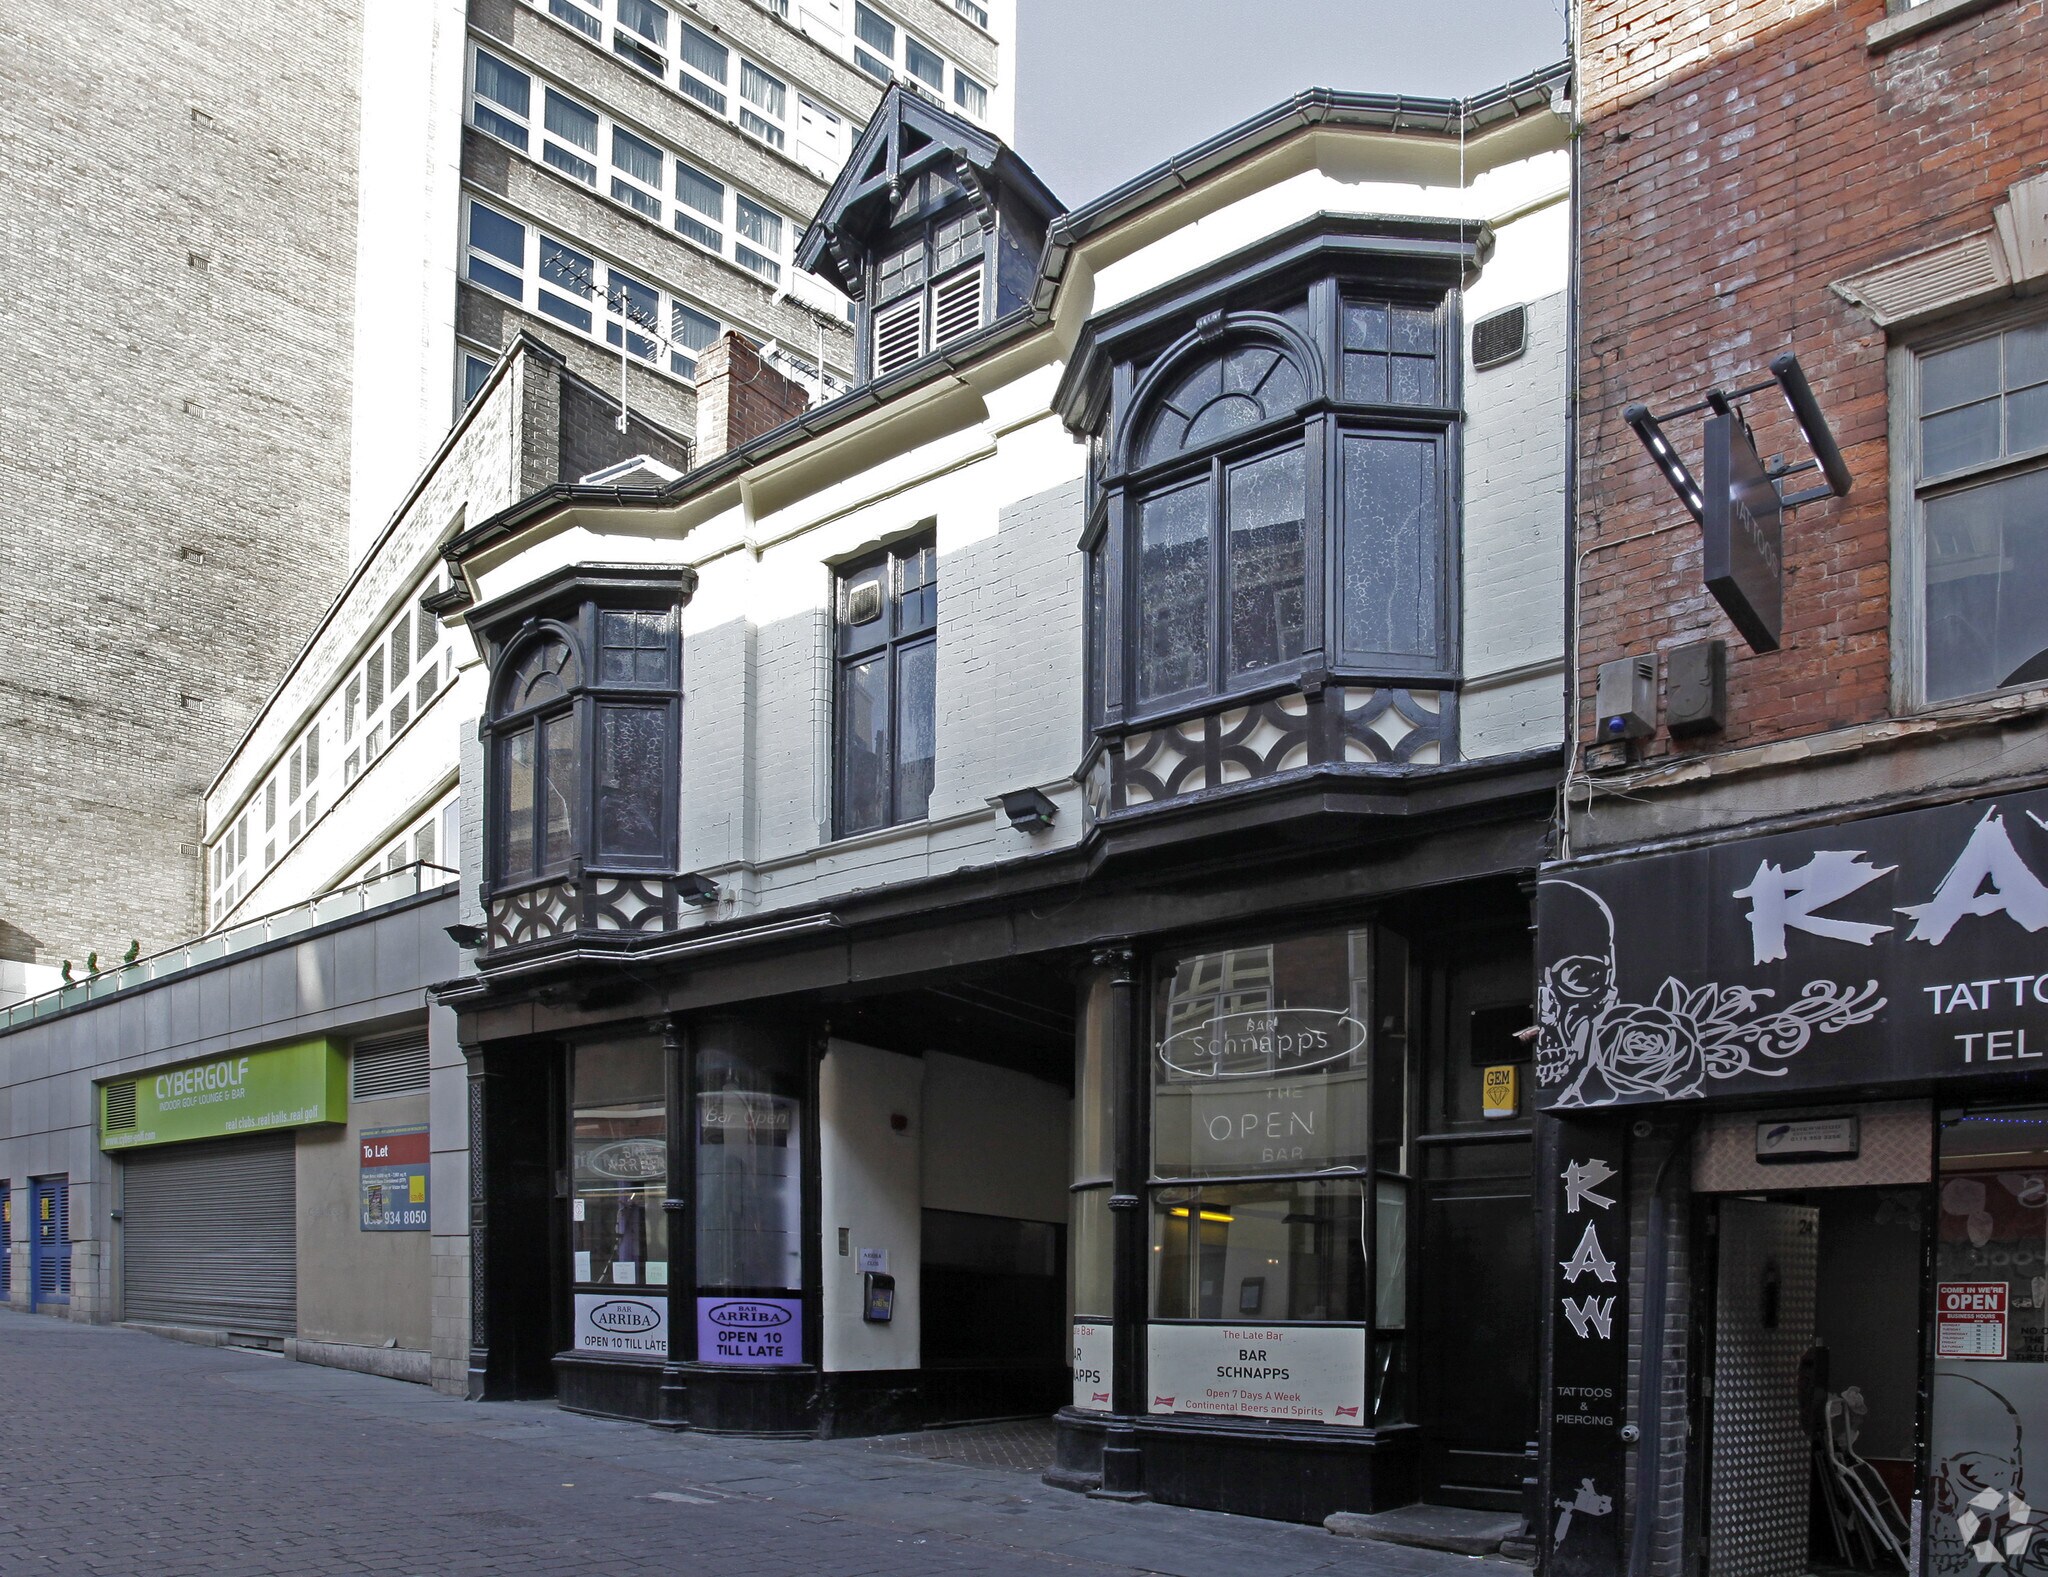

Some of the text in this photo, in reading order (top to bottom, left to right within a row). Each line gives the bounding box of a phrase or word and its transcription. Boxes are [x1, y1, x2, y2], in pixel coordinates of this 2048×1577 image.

[1732, 804, 2048, 966] RA
[1954, 1029, 2043, 1063] TEL
[156, 1057, 249, 1099] CYBERGOLF
[1486, 1070, 1510, 1086] GEM
[159, 1087, 246, 1112] INDOOR GOLF LOUNGE & BAR
[225, 1119, 238, 1131] real
[304, 1104, 319, 1122] golf
[1209, 1111, 1315, 1141] OPEN
[363, 1145, 388, 1158] To Let
[384, 1211, 401, 1225] 934
[403, 1210, 427, 1225] 8050
[1559, 1158, 1619, 1340] RAW
[1946, 1294, 1998, 1310] OPEN
[598, 1312, 652, 1326] ARRIBA
[716, 1311, 780, 1322] ARRIBA
[718, 1331, 782, 1343] OPEN 10
[1081, 1326, 1095, 1336] Bar
[1223, 1330, 1284, 1341] The Late Bar
[584, 1335, 667, 1351] OPEN 10 TILL LATE
[717, 1344, 783, 1357] TILL LATE
[1239, 1349, 1267, 1361] BAR
[1217, 1366, 1290, 1380] SCHNAPPS
[1206, 1388, 1301, 1402] Open 7 Days A Week
[1557, 1386, 1613, 1398] TATTOOS
[1185, 1400, 1238, 1411] Continental
[1241, 1403, 1269, 1413] Beers
[1271, 1405, 1289, 1414] and
[1291, 1406, 1324, 1417] Spirits
[1579, 1401, 1588, 1411] &
[1556, 1414, 1613, 1426] PIERCING
